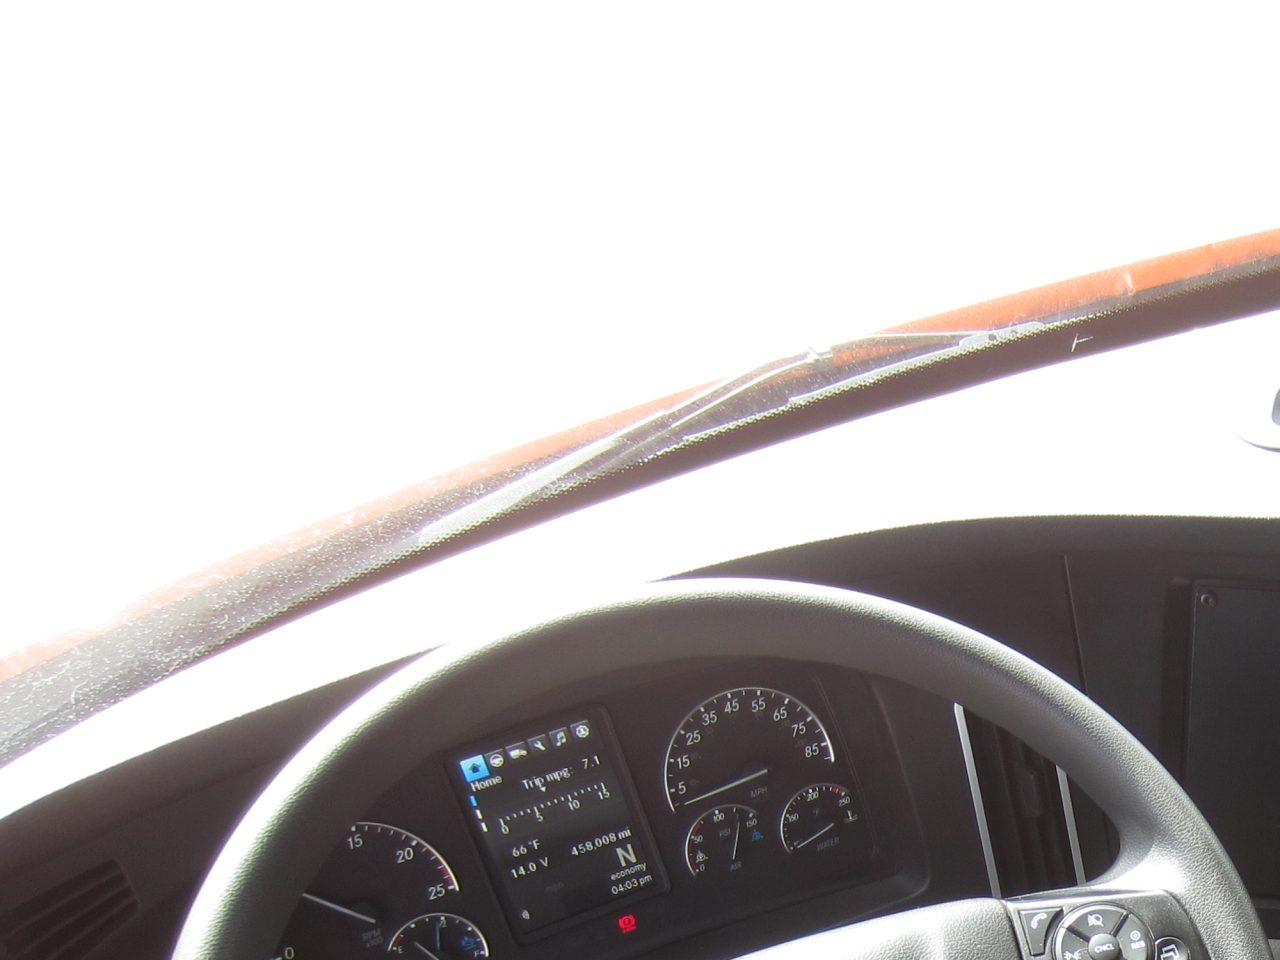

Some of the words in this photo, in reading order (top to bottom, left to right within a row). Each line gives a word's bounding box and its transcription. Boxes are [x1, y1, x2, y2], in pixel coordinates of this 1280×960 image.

[724, 699, 740, 714] 45
[751, 698, 766, 713] 55
[702, 711, 718, 726] 35
[773, 707, 788, 722] 65
[791, 721, 807, 737] 75
[686, 730, 701, 746] 25
[804, 743, 820, 758] 85
[676, 754, 690, 769] 15
[522, 775, 545, 791] Trip
[545, 766, 575, 784] mpg:
[581, 755, 600, 770] 7.1
[470, 775, 503, 792] Home
[678, 782, 687, 795] 5
[750, 786, 768, 799] MPH
[806, 790, 819, 802] 200
[536, 812, 544, 823] 5
[568, 799, 581, 811] 10
[598, 789, 611, 801] 15
[838, 796, 851, 807] 250
[712, 812, 725, 824] 100
[745, 817, 758, 829] 150
[618, 826, 632, 840] mi
[694, 834, 704, 844] 50
[719, 827, 731, 839] PSI
[347, 834, 364, 850] 15
[816, 836, 840, 852] WATER
[396, 847, 414, 864] 20
[512, 845, 528, 858] 66
[615, 843, 638, 867] N
[511, 861, 537, 878] 14.0
[539, 857, 549, 868] V
[610, 861, 648, 881] economy
[729, 860, 743, 873] AIR
[611, 877, 639, 895] 04:03
[639, 873, 653, 887] pm
[428, 884, 446, 900] 25
[362, 928, 381, 942] RPM
[284, 946, 295, 960] 0
[1094, 943, 1115, 953] CNCL
